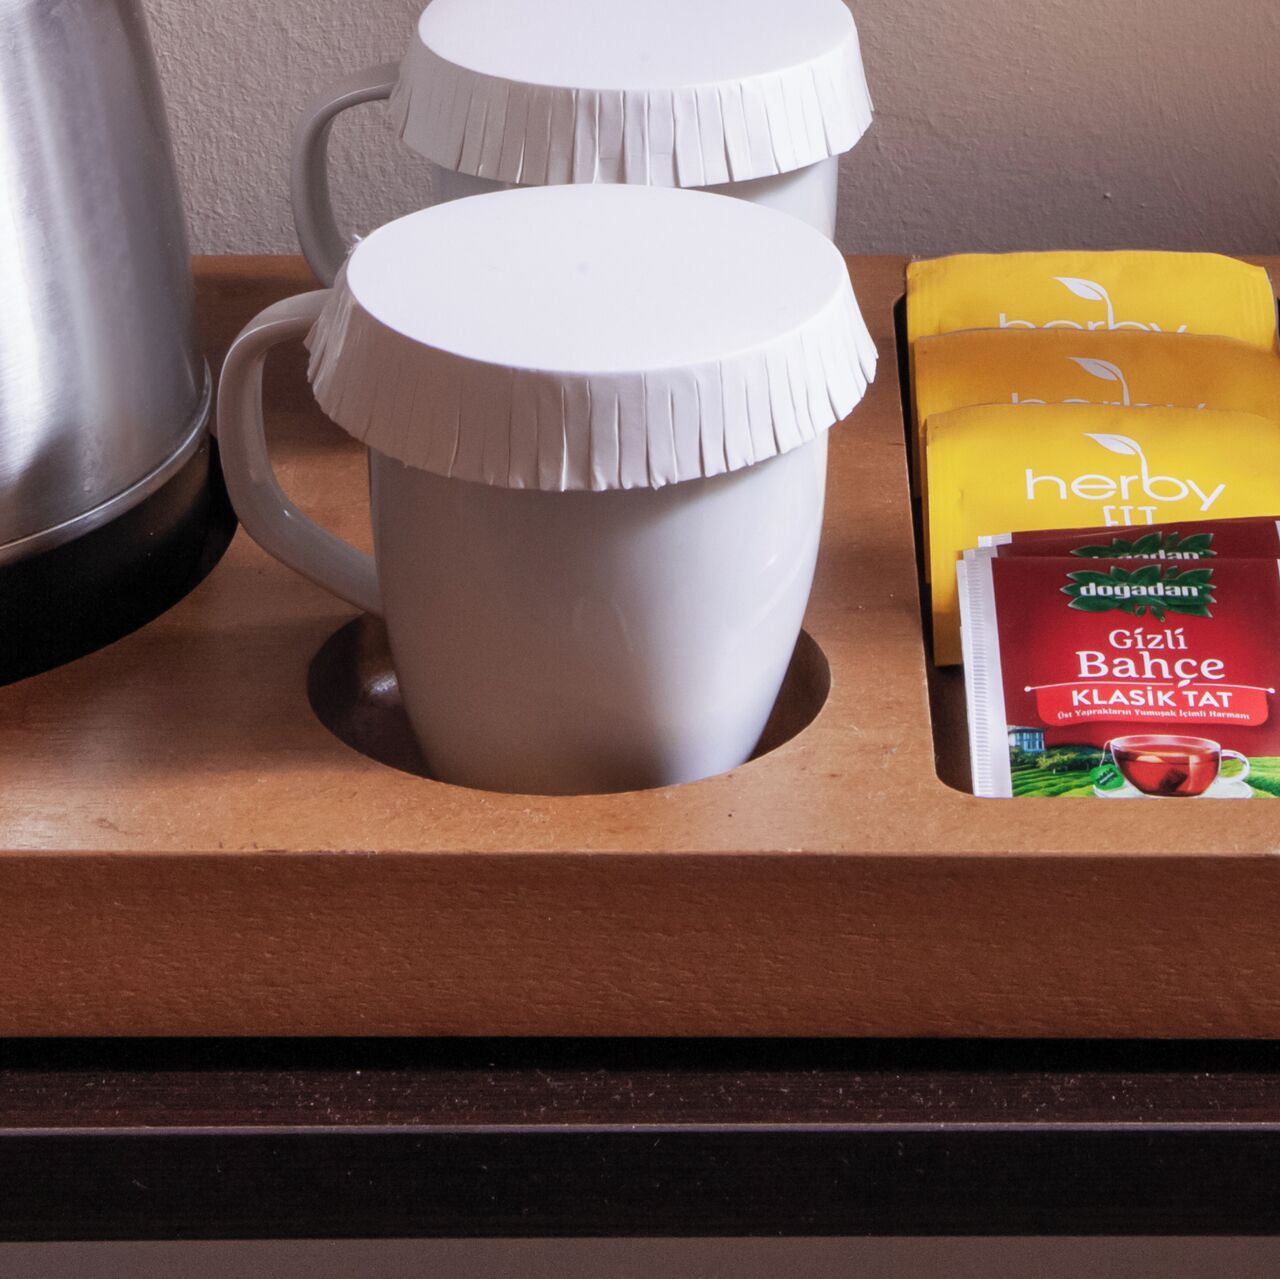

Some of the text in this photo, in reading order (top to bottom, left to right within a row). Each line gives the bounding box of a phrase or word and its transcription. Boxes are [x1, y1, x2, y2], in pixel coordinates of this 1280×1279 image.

[1023, 464, 1227, 512] herby
[1102, 504, 1158, 527] FIT
[1107, 626, 1188, 650] Gizli
[1074, 649, 1226, 689] Bahçe
[1071, 686, 1233, 708] KLASİK TAT
[1057, 708, 1251, 721] Üst Yaprakların Yumuşak İçimli Harmanı
